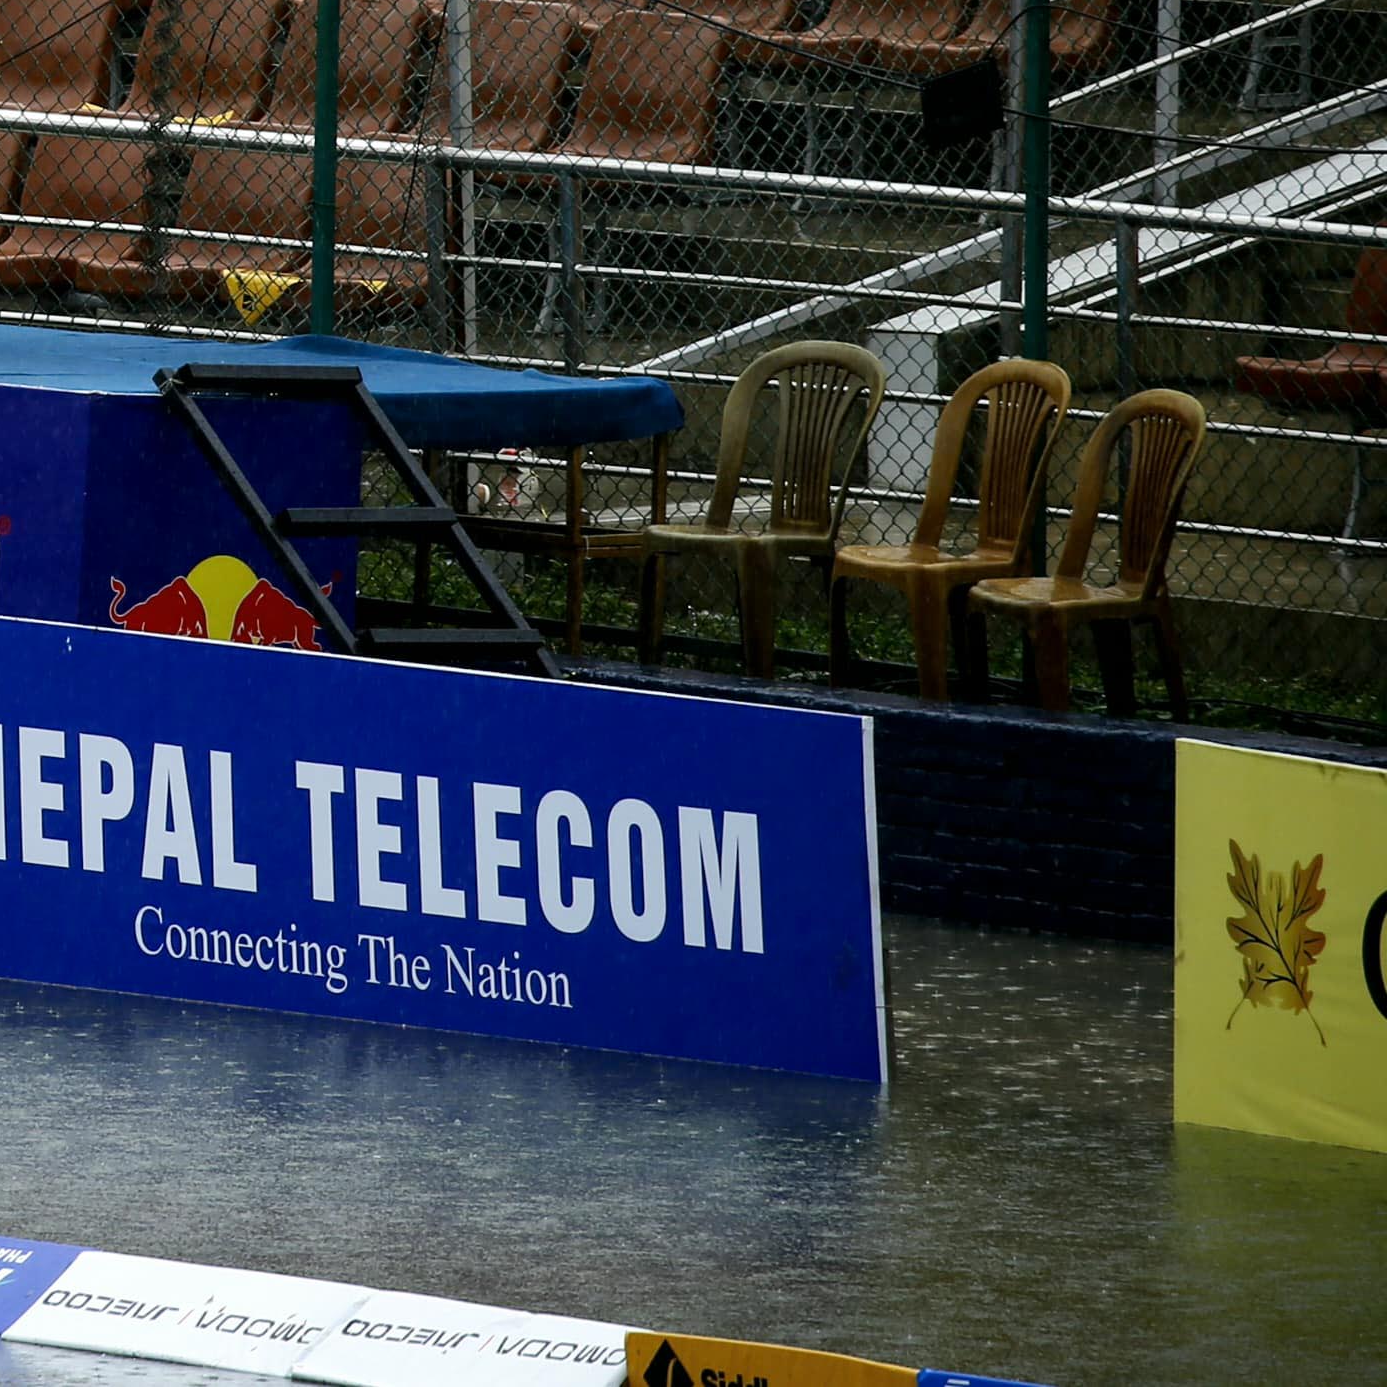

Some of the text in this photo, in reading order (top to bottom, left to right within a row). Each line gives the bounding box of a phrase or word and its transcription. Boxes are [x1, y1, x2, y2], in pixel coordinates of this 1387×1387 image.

[295, 761, 765, 955] TELECOM
[133, 905, 573, 1008] Connecting The Nation
